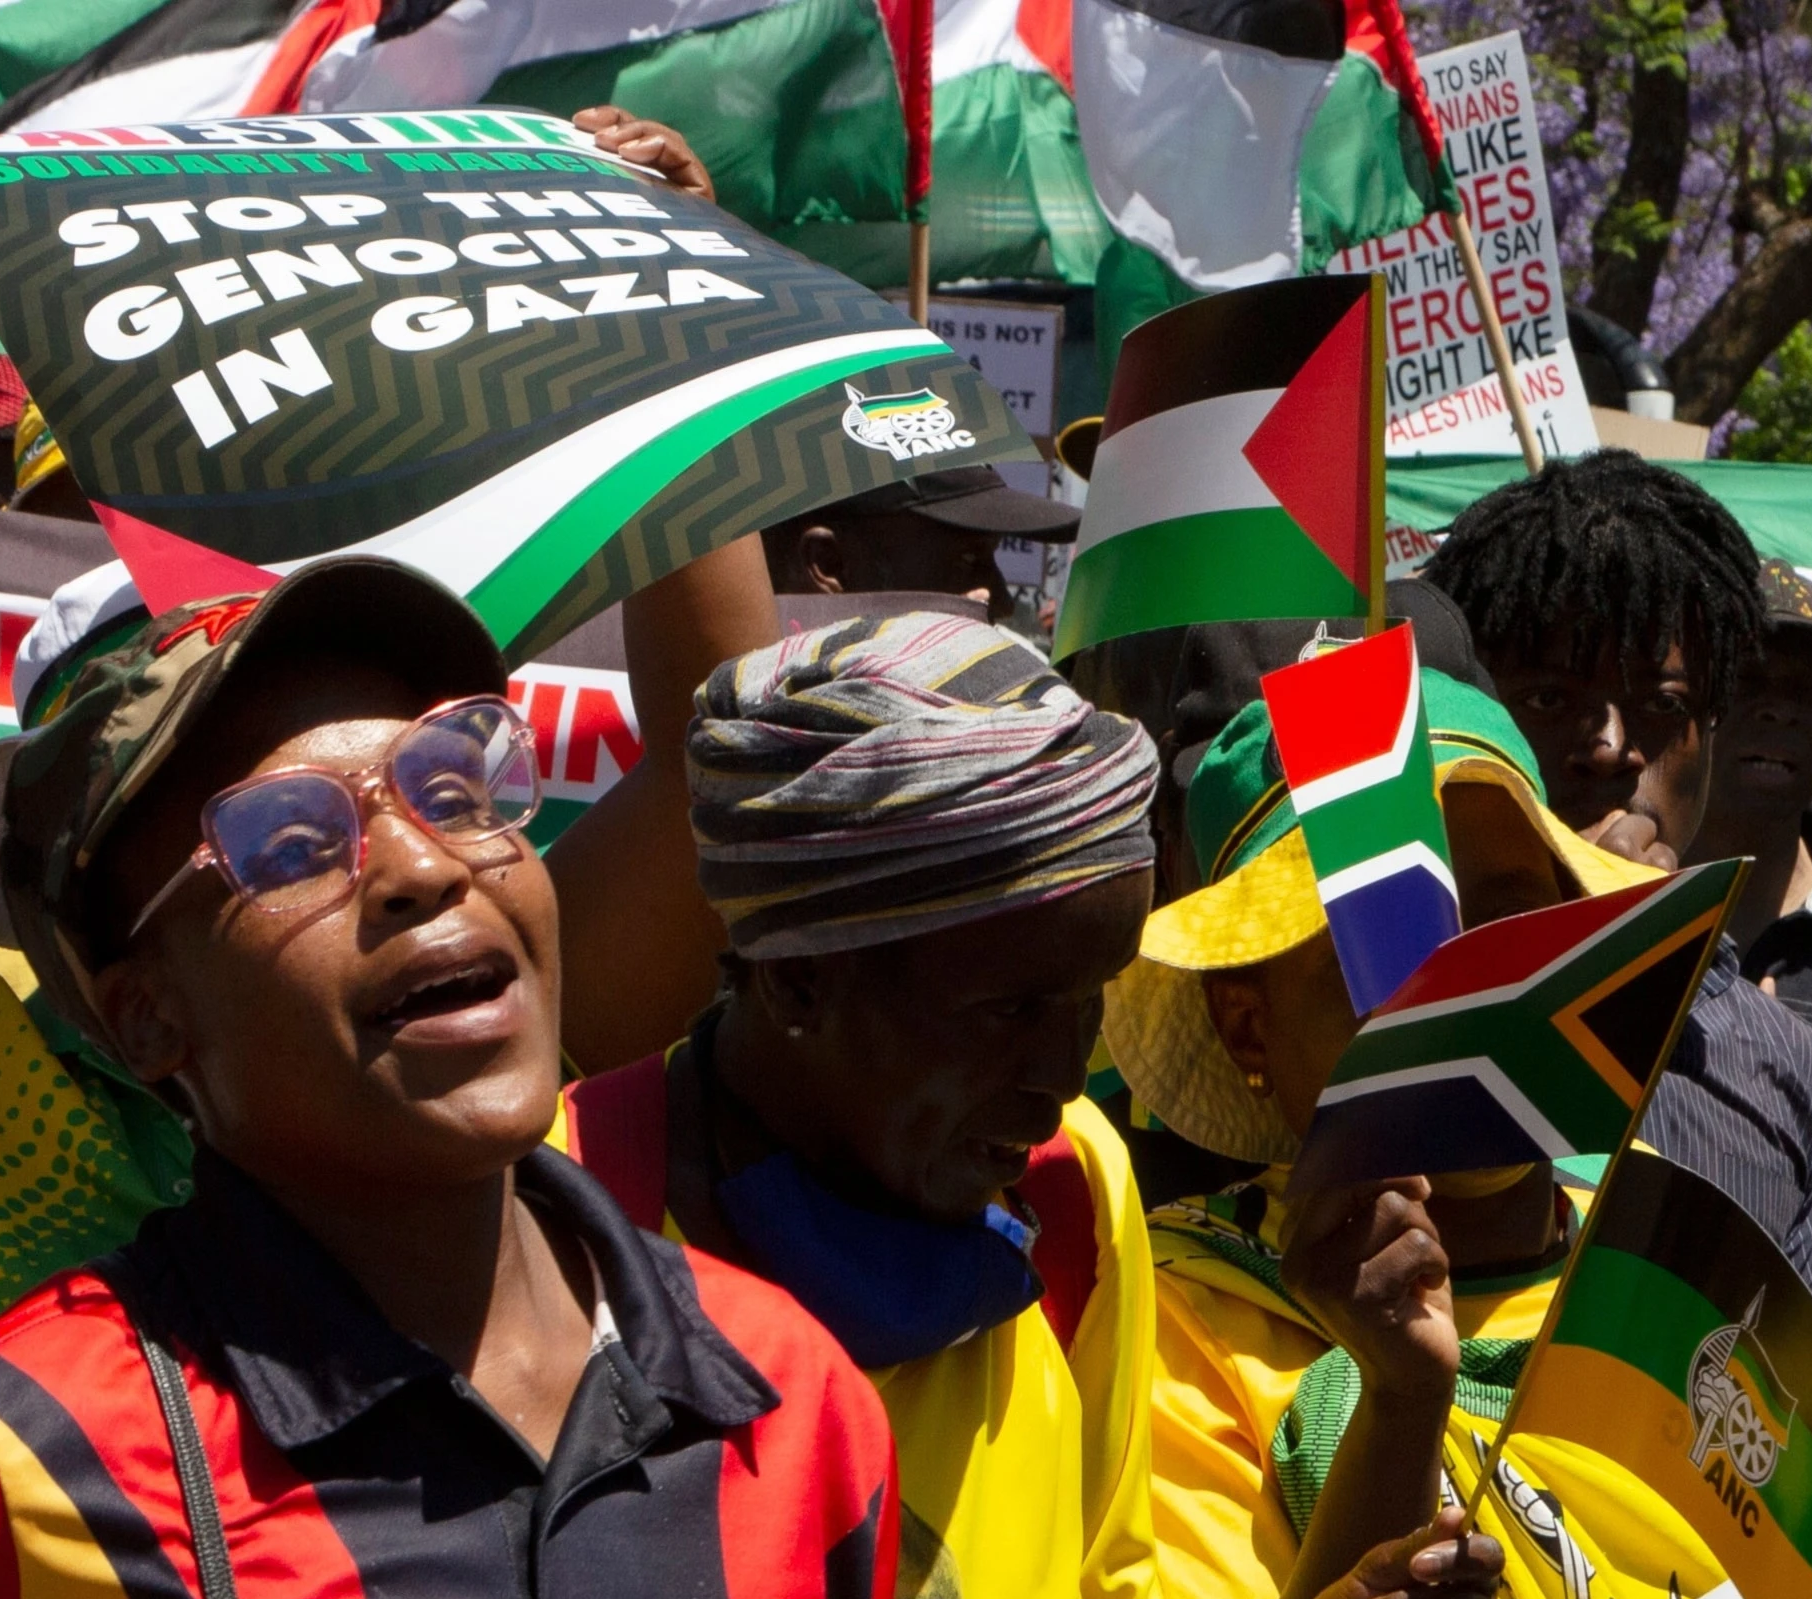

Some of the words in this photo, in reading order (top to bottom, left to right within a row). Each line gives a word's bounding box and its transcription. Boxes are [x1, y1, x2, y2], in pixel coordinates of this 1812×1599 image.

[1434, 65, 1463, 95] TO
[1468, 50, 1508, 91] SAY
[386, 150, 637, 180] MARCH
[1445, 117, 1527, 177] LIKE
[58, 195, 387, 267] STOP
[422, 190, 673, 220] THE
[1493, 219, 1543, 264] SAY
[83, 228, 751, 361] GENOCIDE
[1385, 260, 1551, 359] EROES
[172, 328, 334, 449] IN
[371, 269, 766, 352] GAZA
[964, 320, 988, 340] IS
[994, 324, 1046, 345] NOT
[1385, 341, 1465, 406] IGHT
[1477, 316, 1557, 374] LKE
[910, 429, 976, 458] ANC
[1703, 1457, 1761, 1538] ANC
